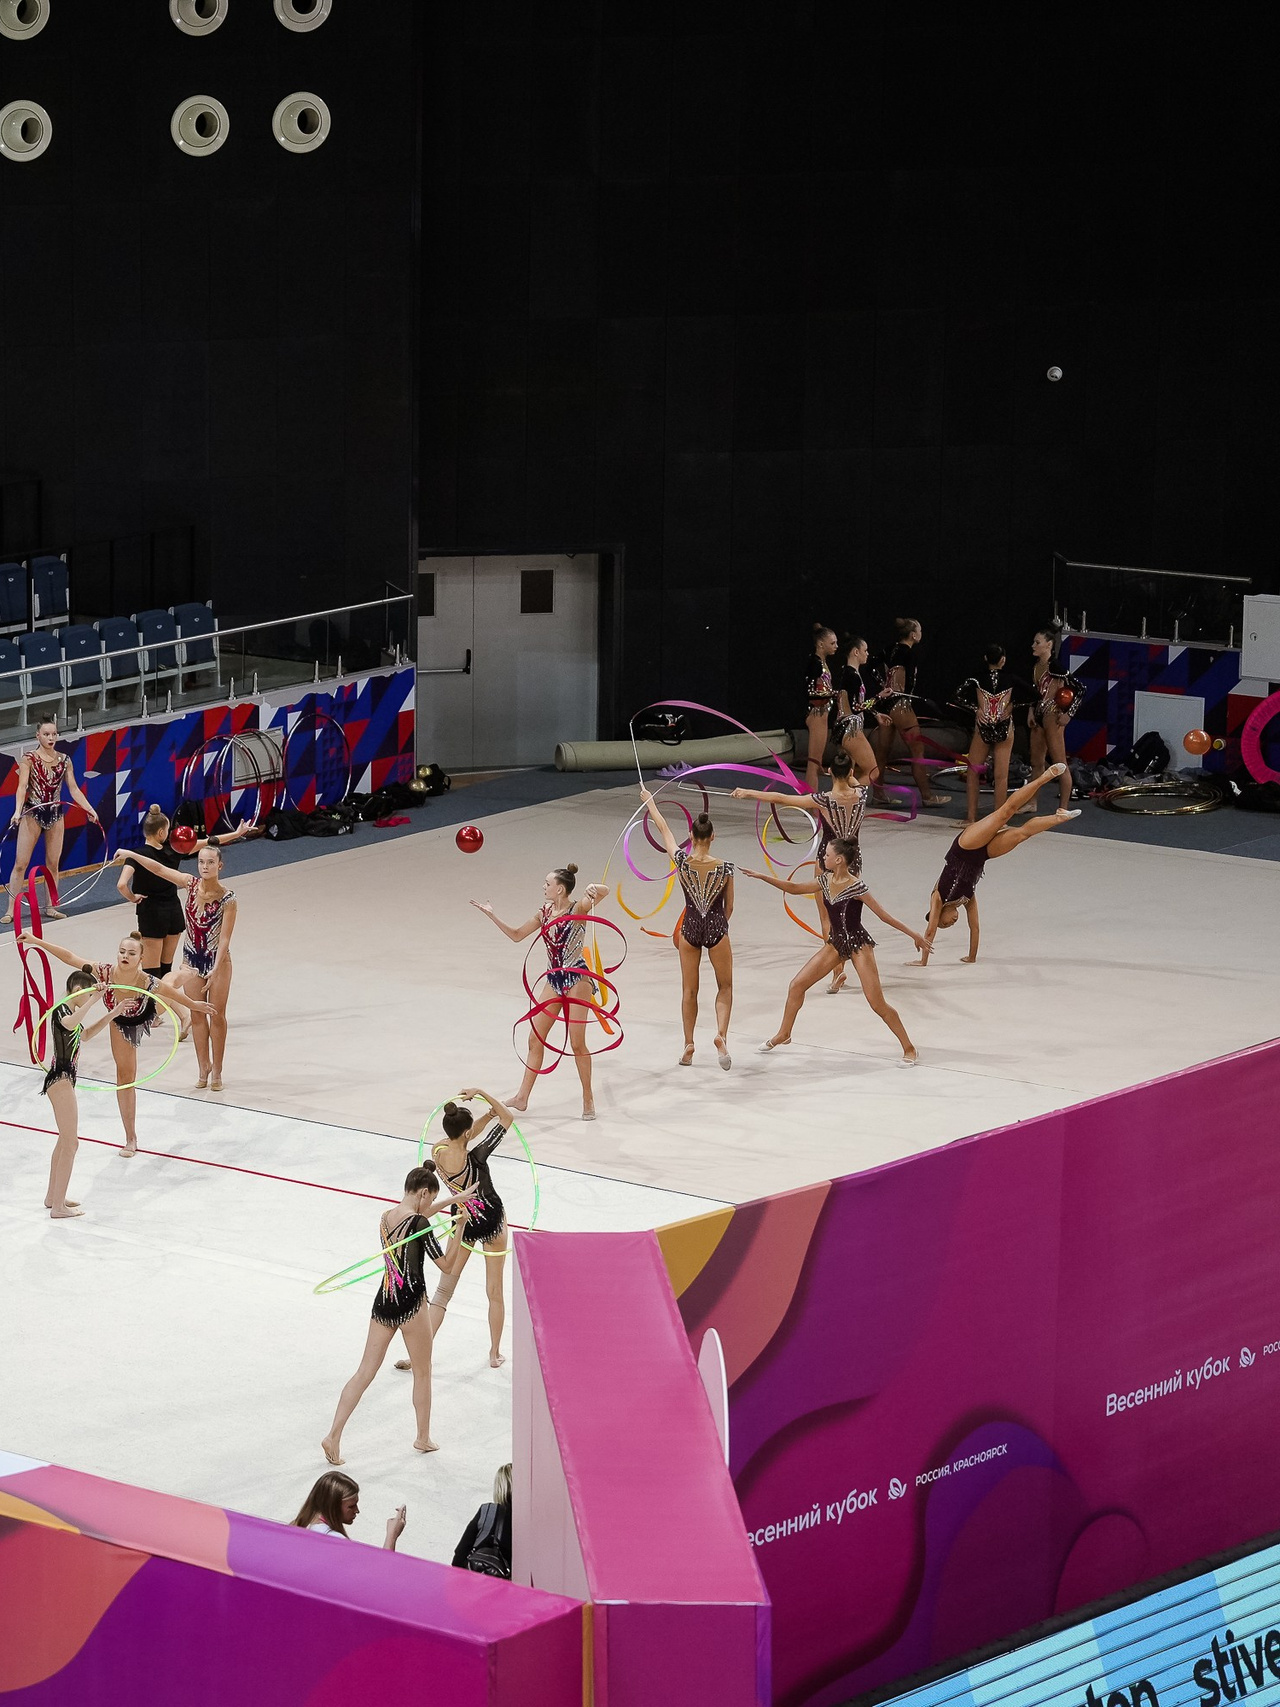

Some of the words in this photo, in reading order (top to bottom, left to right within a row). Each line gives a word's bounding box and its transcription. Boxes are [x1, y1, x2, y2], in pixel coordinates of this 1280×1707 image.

[1105, 1368, 1183, 1417] Весенний
[1186, 1356, 1231, 1390] кубок
[915, 1464, 952, 1487] РОССИЯ,
[953, 1443, 1008, 1473] КРАСНОЯРСК
[747, 1502, 821, 1548] есенний
[826, 1488, 878, 1525] кубок
